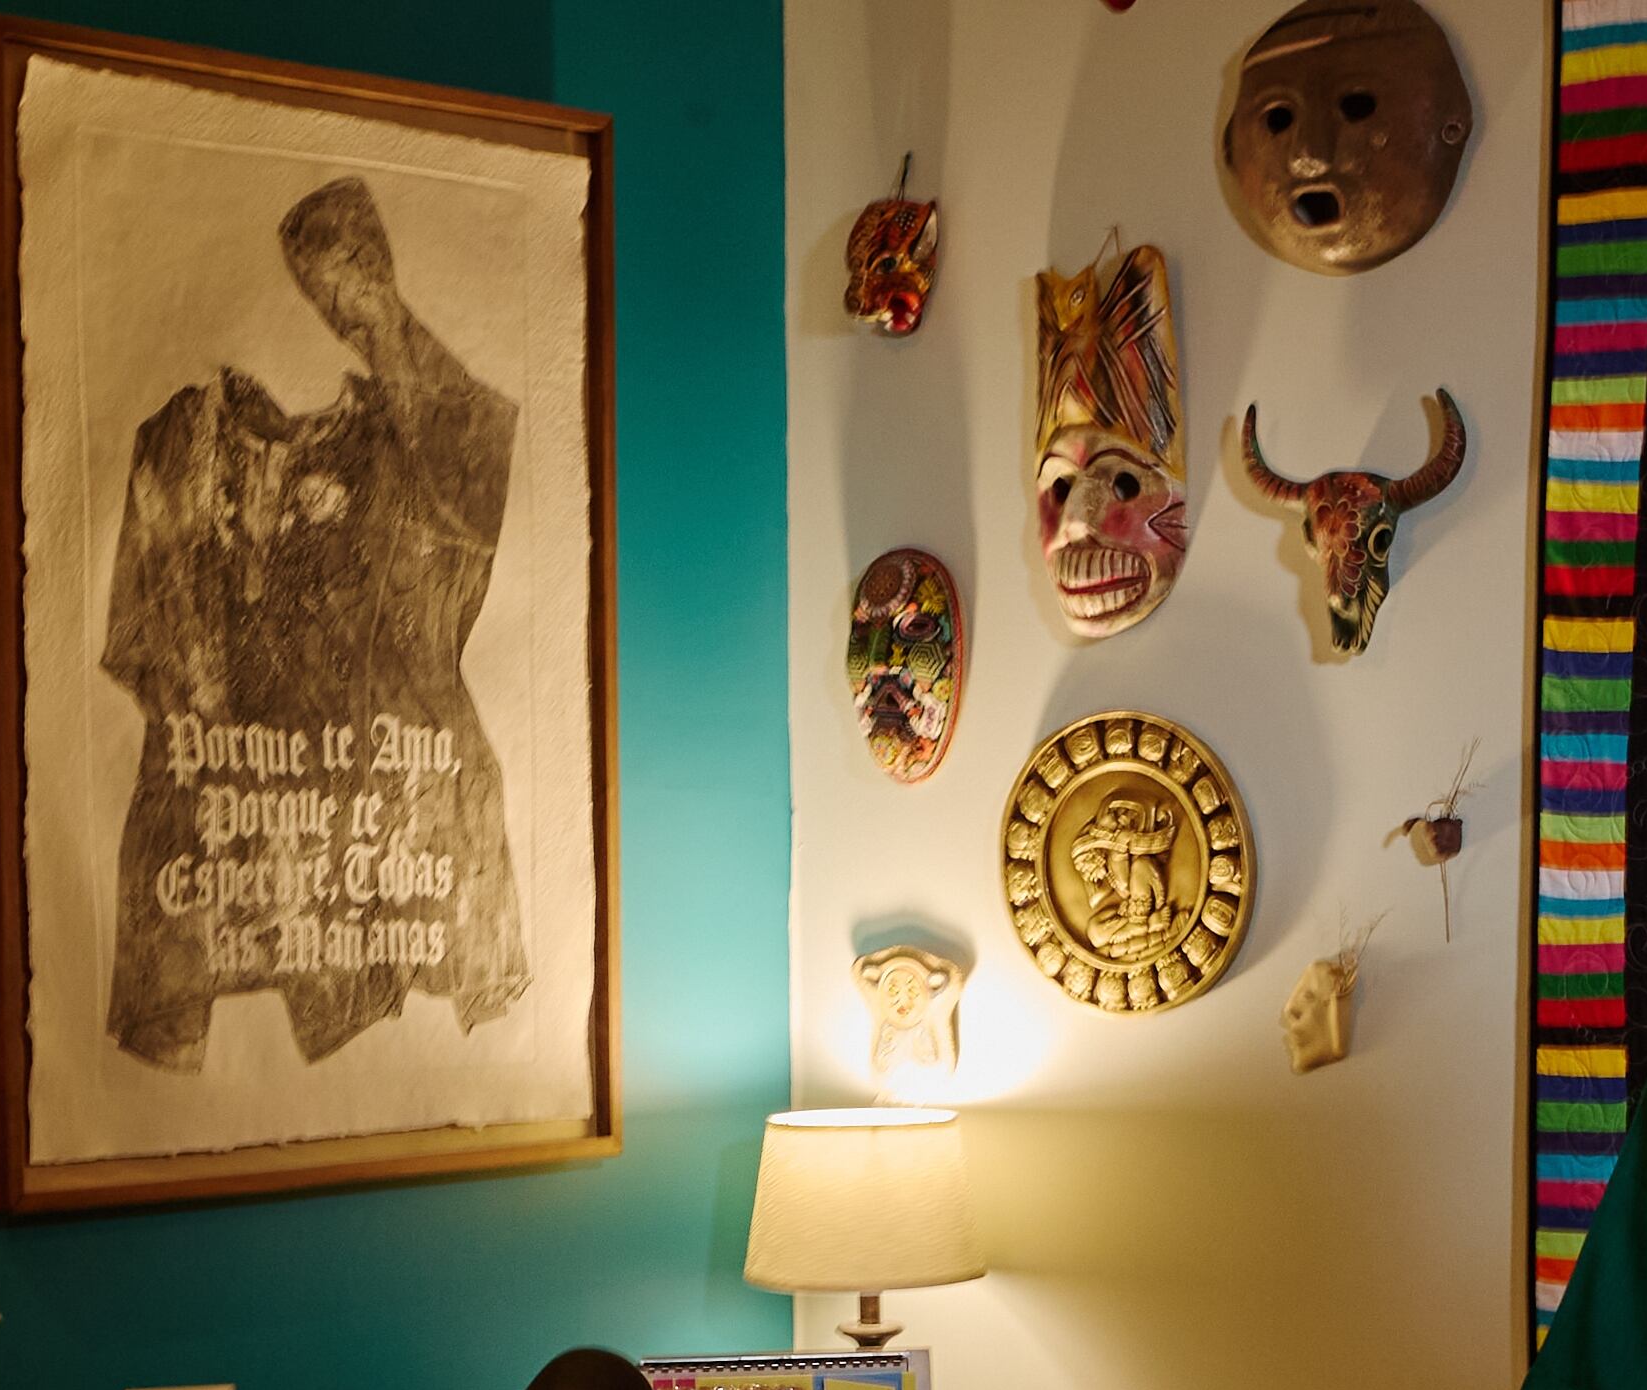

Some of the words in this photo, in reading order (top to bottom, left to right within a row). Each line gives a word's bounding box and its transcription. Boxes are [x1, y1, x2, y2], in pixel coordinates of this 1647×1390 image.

[165, 711, 309, 789] Porque
[323, 720, 356, 769] te
[370, 713, 463, 780] Amo,
[196, 783, 338, 857] Porque
[350, 786, 382, 837] te
[206, 917, 258, 972] las
[273, 910, 447, 975] Mañanas
